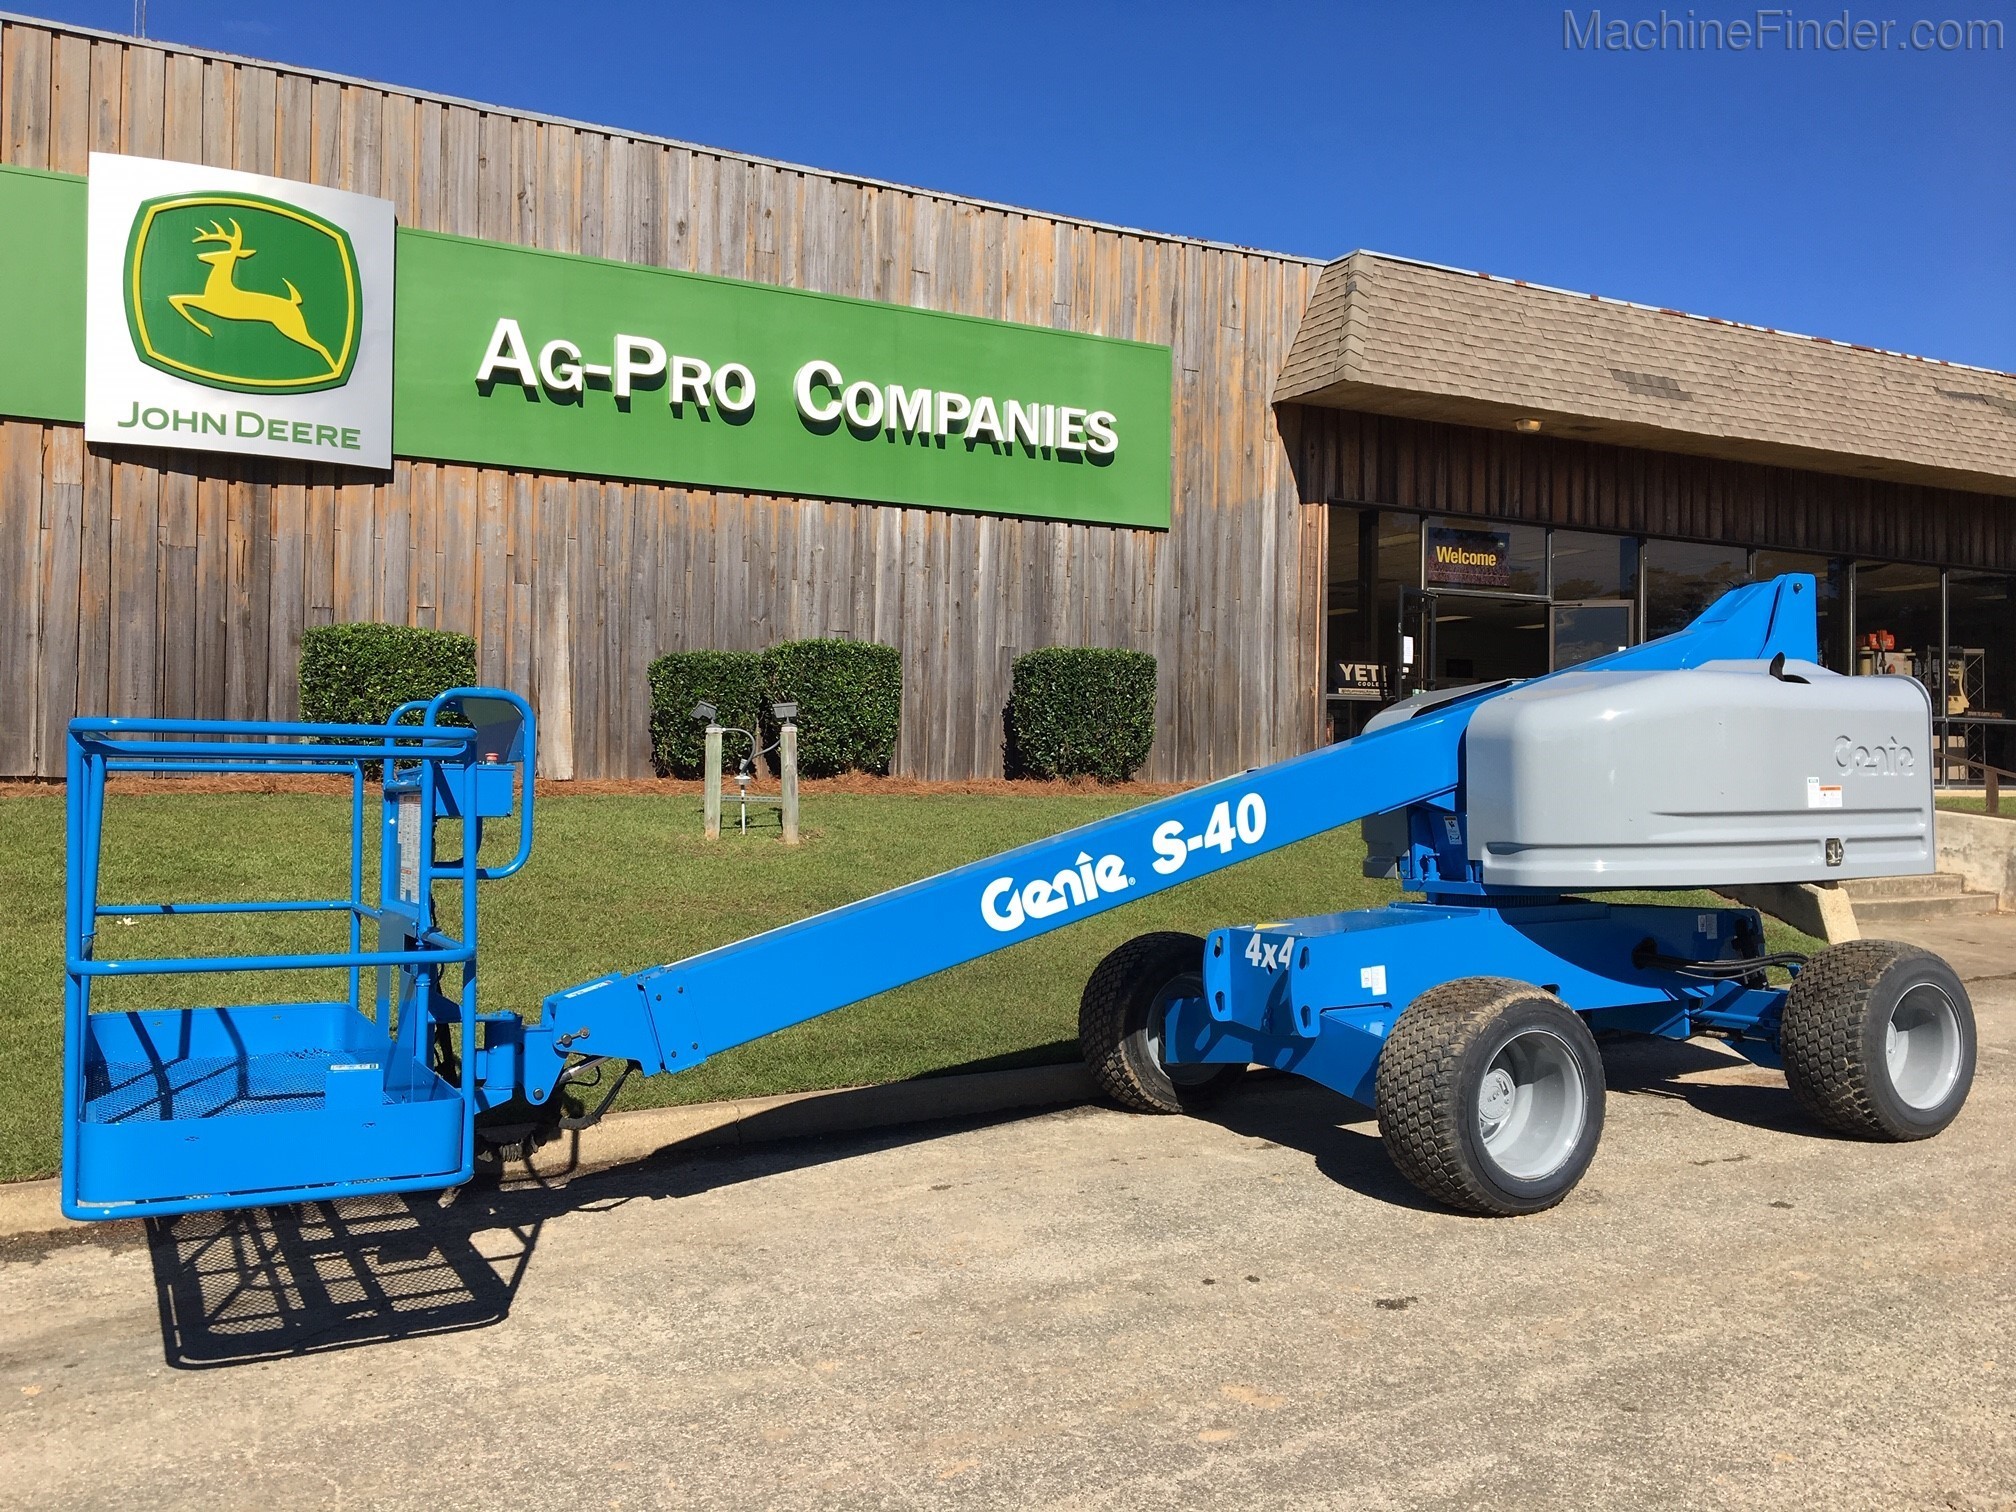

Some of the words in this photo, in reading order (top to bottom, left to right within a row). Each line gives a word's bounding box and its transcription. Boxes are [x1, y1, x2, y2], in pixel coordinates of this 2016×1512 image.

[475, 317, 756, 412] AG-PRO
[793, 360, 1119, 454] COMPANIES
[117, 401, 227, 436] JOHN
[236, 410, 361, 450] DEERE
[1436, 545, 1497, 567] Welcome
[1339, 663, 1387, 682] YETI
[1835, 734, 1915, 776] Genie
[1151, 792, 1267, 875] S-40
[1244, 933, 1295, 971] 4x4
